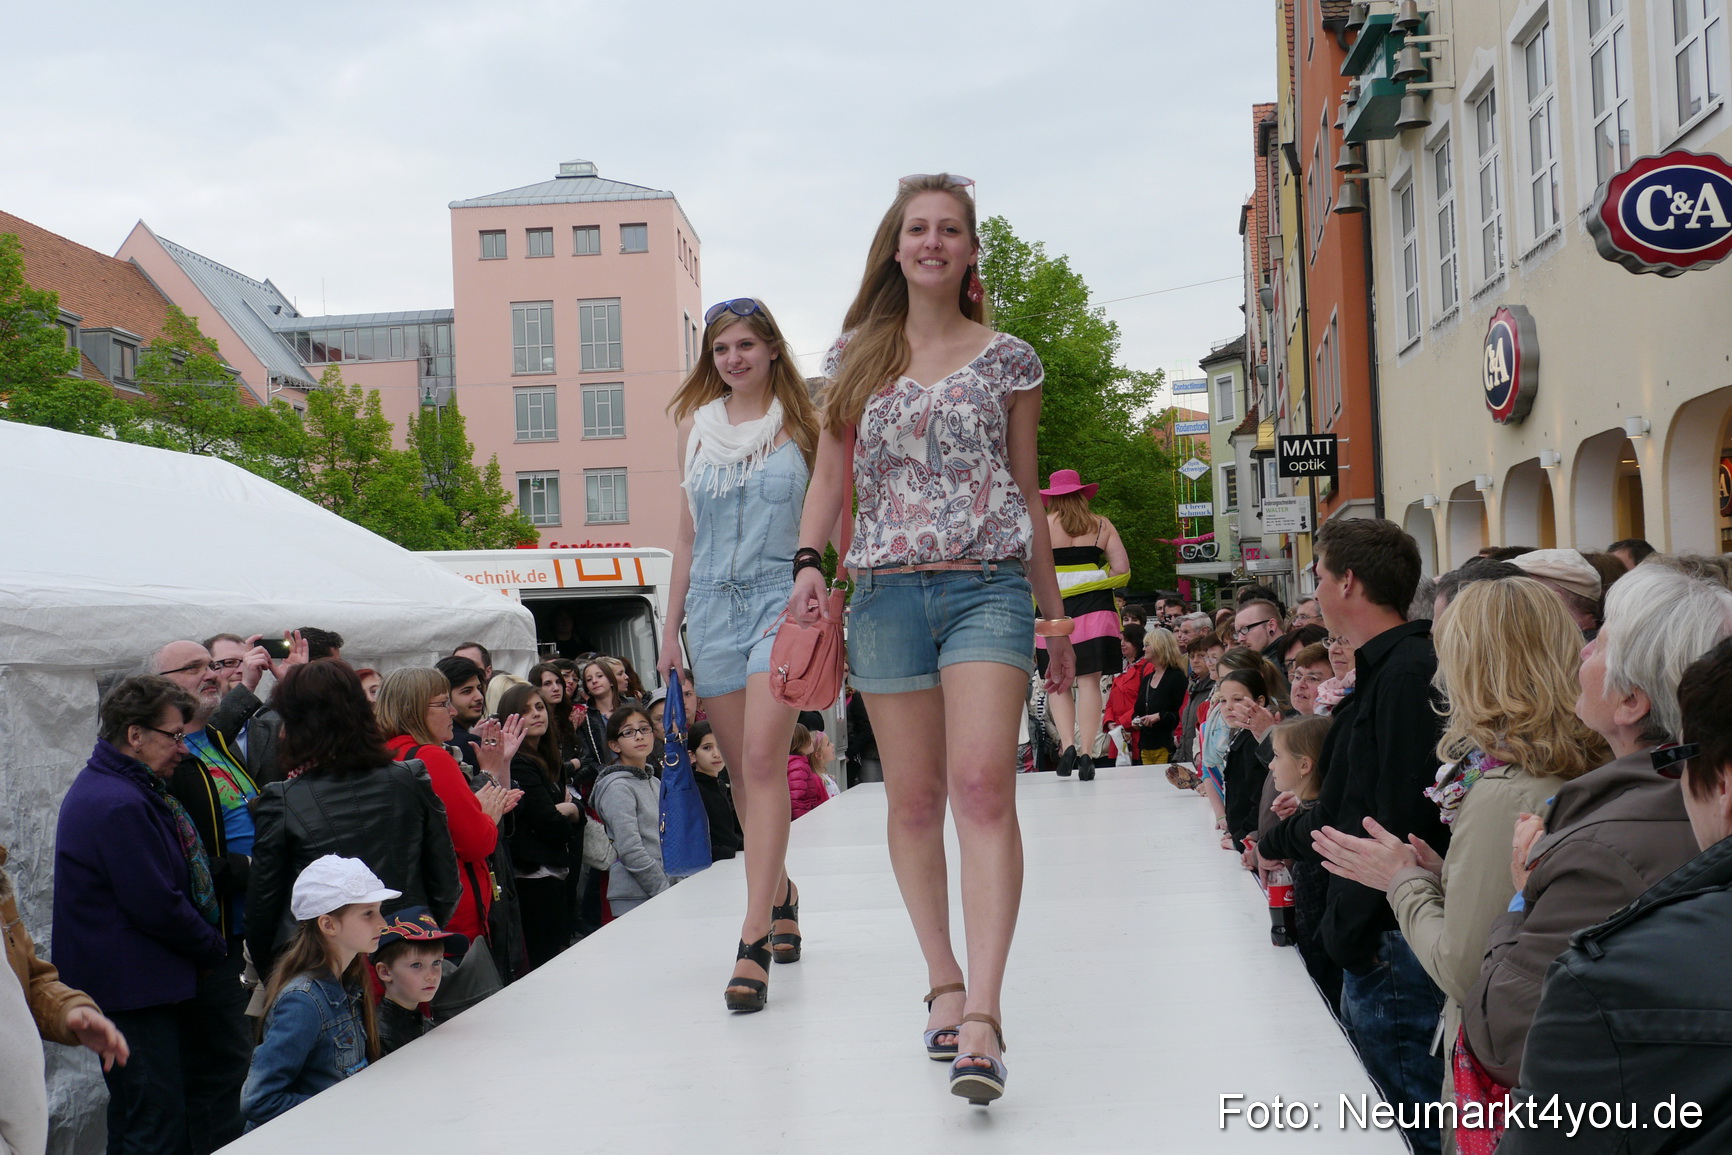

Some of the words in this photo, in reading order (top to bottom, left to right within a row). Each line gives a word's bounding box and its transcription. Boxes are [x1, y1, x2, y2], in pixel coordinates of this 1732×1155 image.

[1635, 183, 1731, 232] C&A
[1483, 338, 1510, 391] C&A
[1173, 382, 1206, 391] Contactlinsen
[1175, 422, 1208, 433] Rodenstock
[1283, 438, 1333, 457] MATT
[1289, 459, 1326, 473] optik
[1180, 509, 1212, 517] Schmuck
[1265, 506, 1289, 514] WALTER
[456, 569, 547, 585] echnik.de
